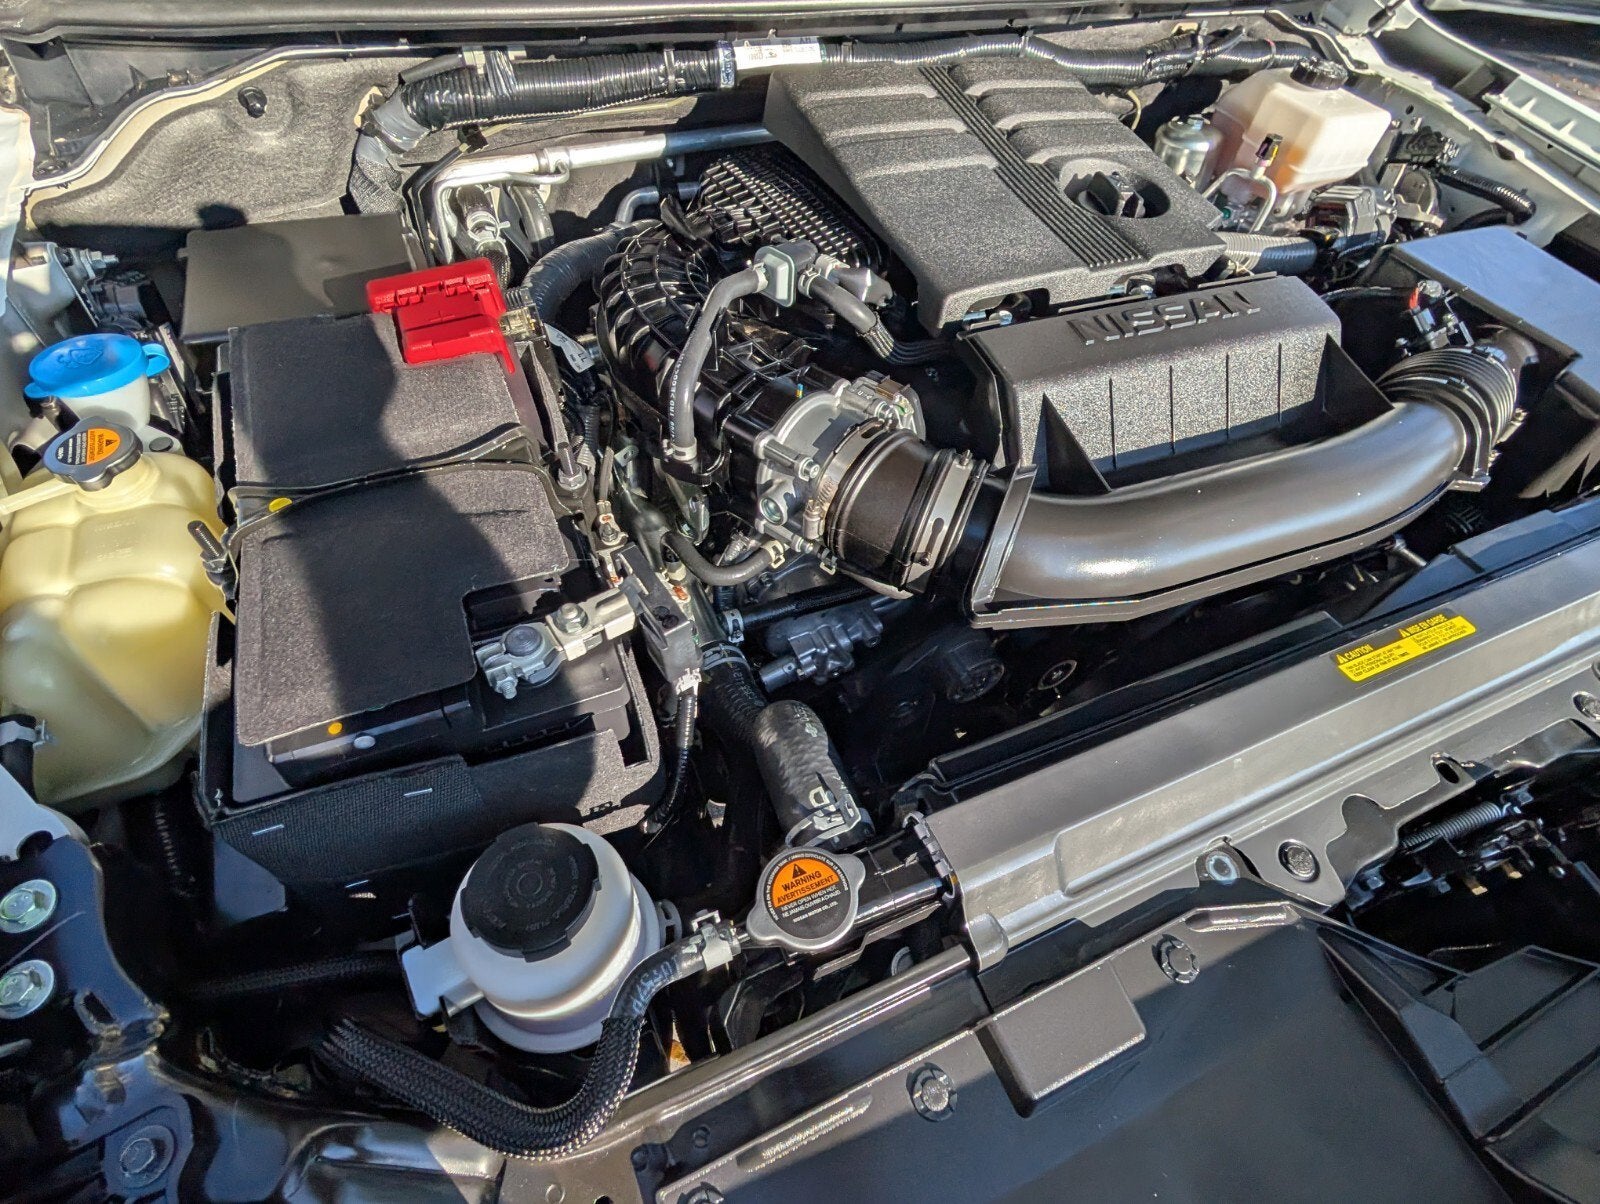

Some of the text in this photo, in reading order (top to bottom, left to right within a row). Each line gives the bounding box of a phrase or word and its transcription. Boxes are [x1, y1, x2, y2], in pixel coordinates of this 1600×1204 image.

[1066, 290, 1260, 346] NISSAN
[1344, 644, 1374, 660] CAUTION
[777, 875, 834, 904] AVERTISSEMENT
[782, 871, 822, 892] WARNING
[781, 902, 798, 912] NEVER
[798, 896, 812, 905] OPEN
[811, 890, 827, 900] WHEN
[790, 904, 805, 916] JAMAIS
